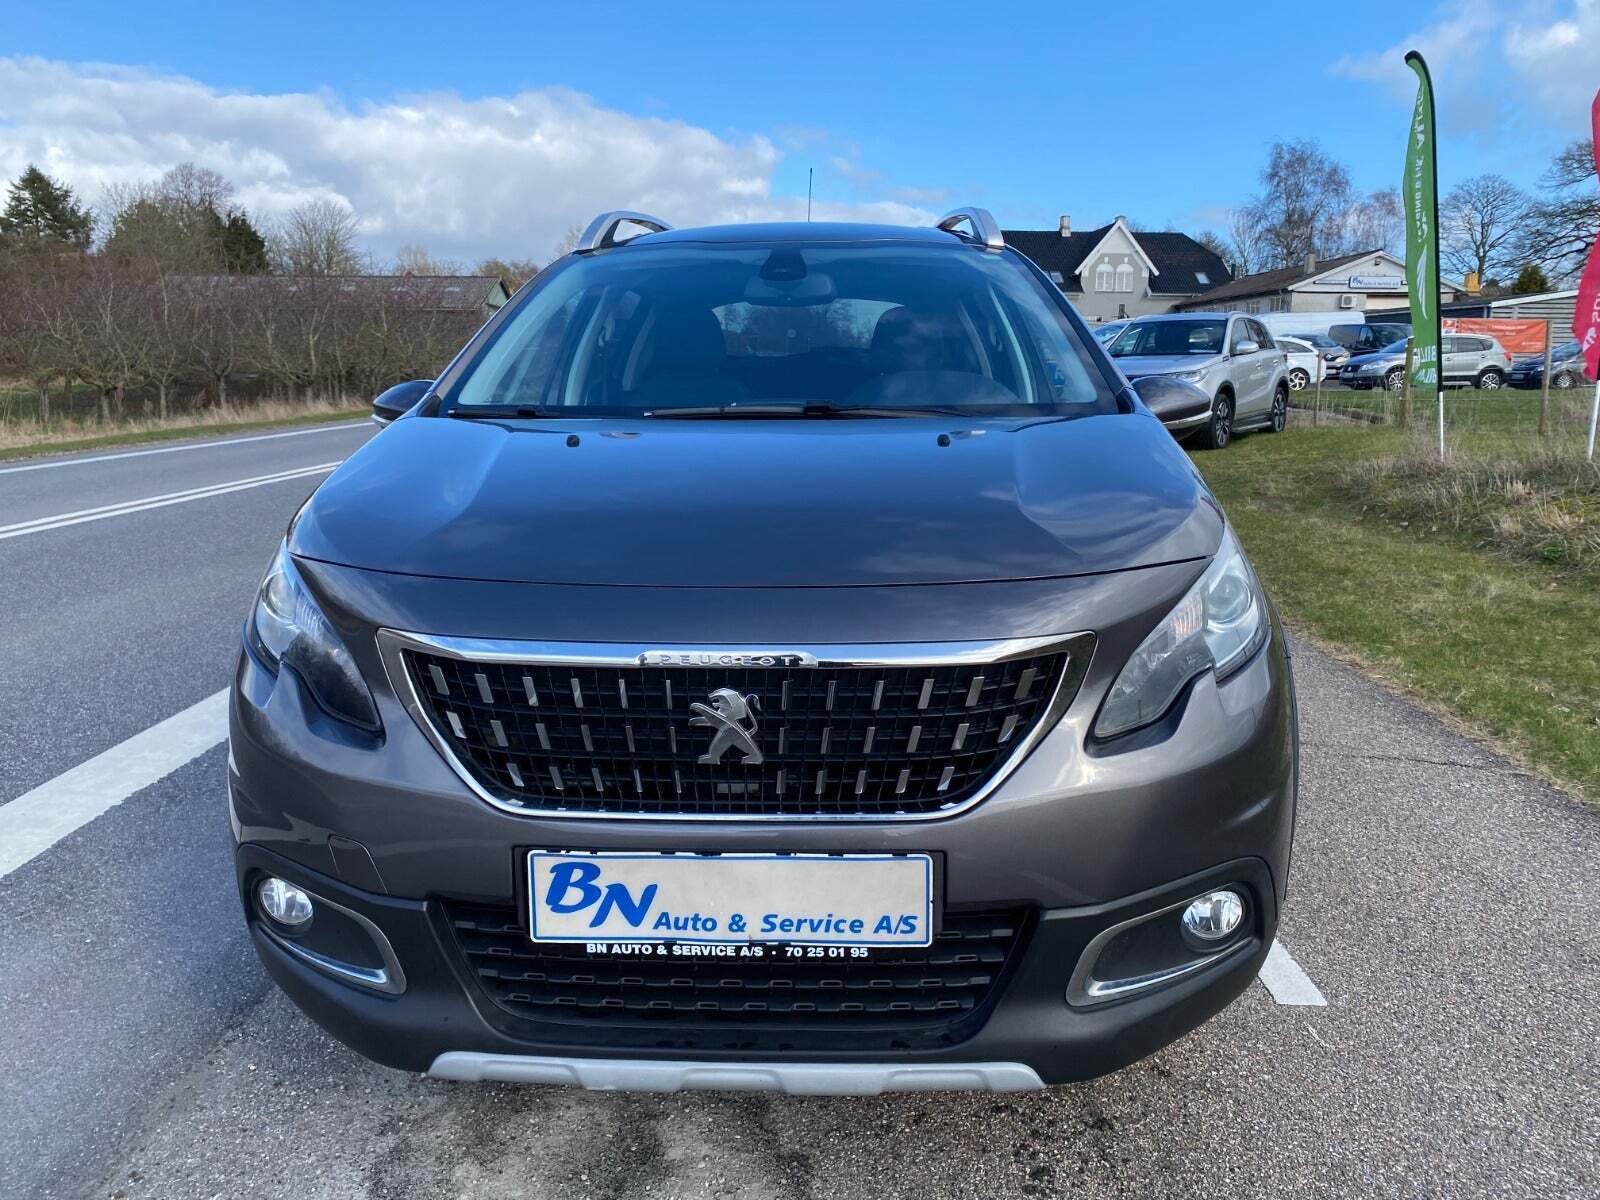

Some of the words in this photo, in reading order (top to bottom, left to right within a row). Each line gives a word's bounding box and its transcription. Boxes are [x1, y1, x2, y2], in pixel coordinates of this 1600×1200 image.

[659, 654, 794, 666] PEUGEOT
[545, 861, 658, 928] BN
[653, 911, 718, 932] Auto
[728, 913, 747, 933] &
[760, 913, 865, 934] Service
[873, 914, 919, 935] A/S
[586, 943, 607, 954] BN
[611, 944, 653, 955] AUTO
[656, 945, 668, 955] &
[672, 945, 736, 957] SERVICE
[740, 946, 763, 957] A/S
[785, 947, 803, 958] 70
[807, 947, 825, 958] 25
[828, 947, 845, 958] 01
[850, 947, 868, 958] 95
